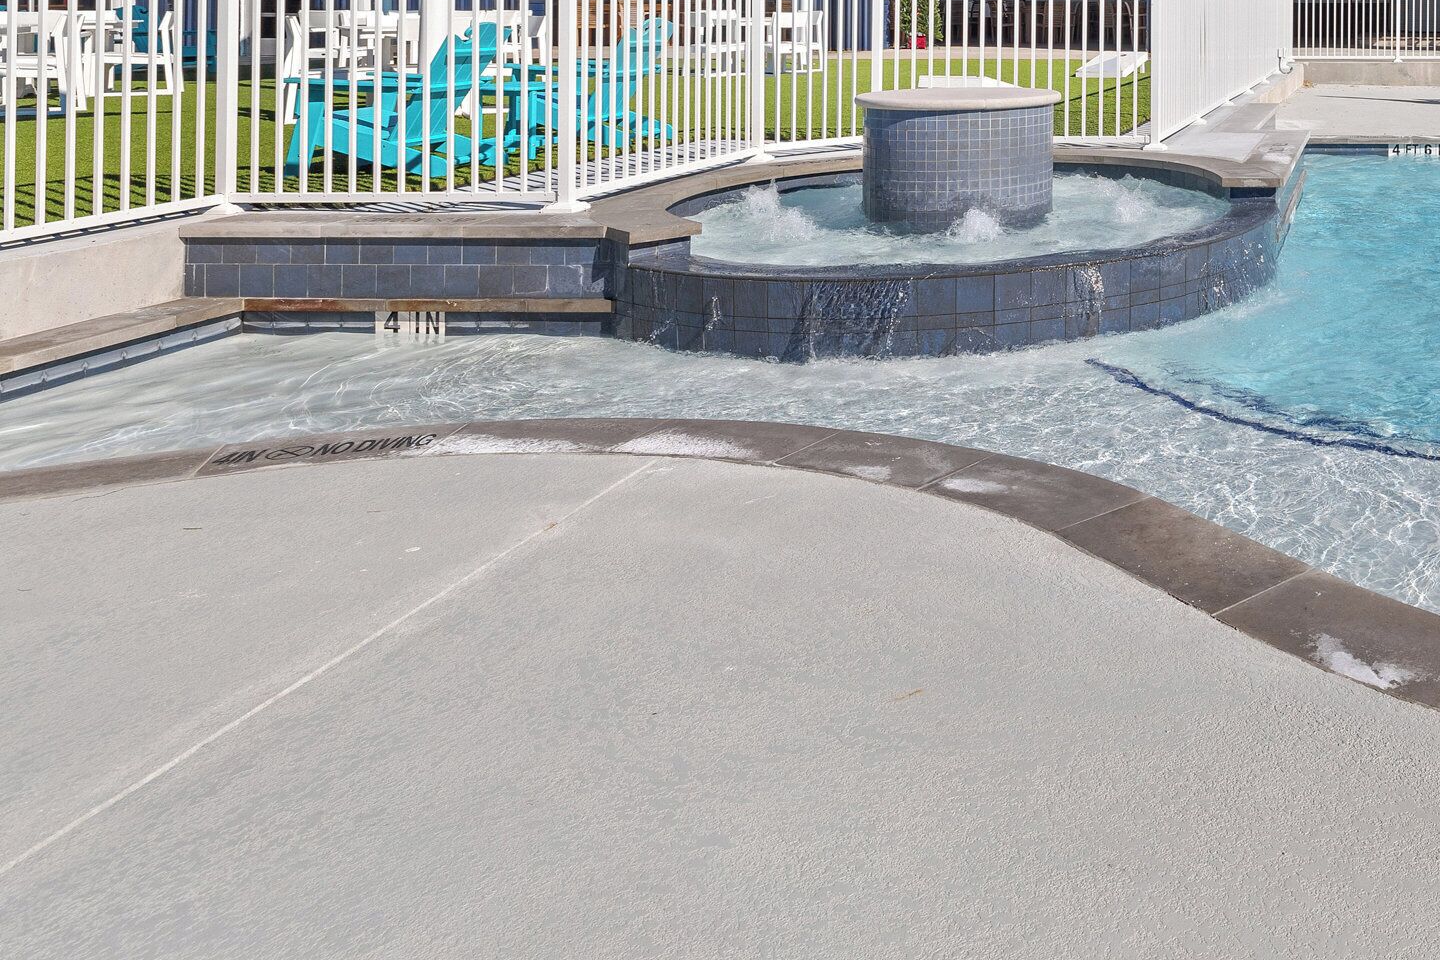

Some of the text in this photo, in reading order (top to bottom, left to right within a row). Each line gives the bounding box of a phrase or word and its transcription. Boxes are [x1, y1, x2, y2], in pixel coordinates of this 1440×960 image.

[1392, 144, 1401, 156] 4
[1405, 144, 1418, 155] FT
[1424, 144, 1432, 155] 6
[384, 311, 440, 334] 4 IN
[312, 441, 353, 456] NO
[354, 433, 437, 453] DIVING
